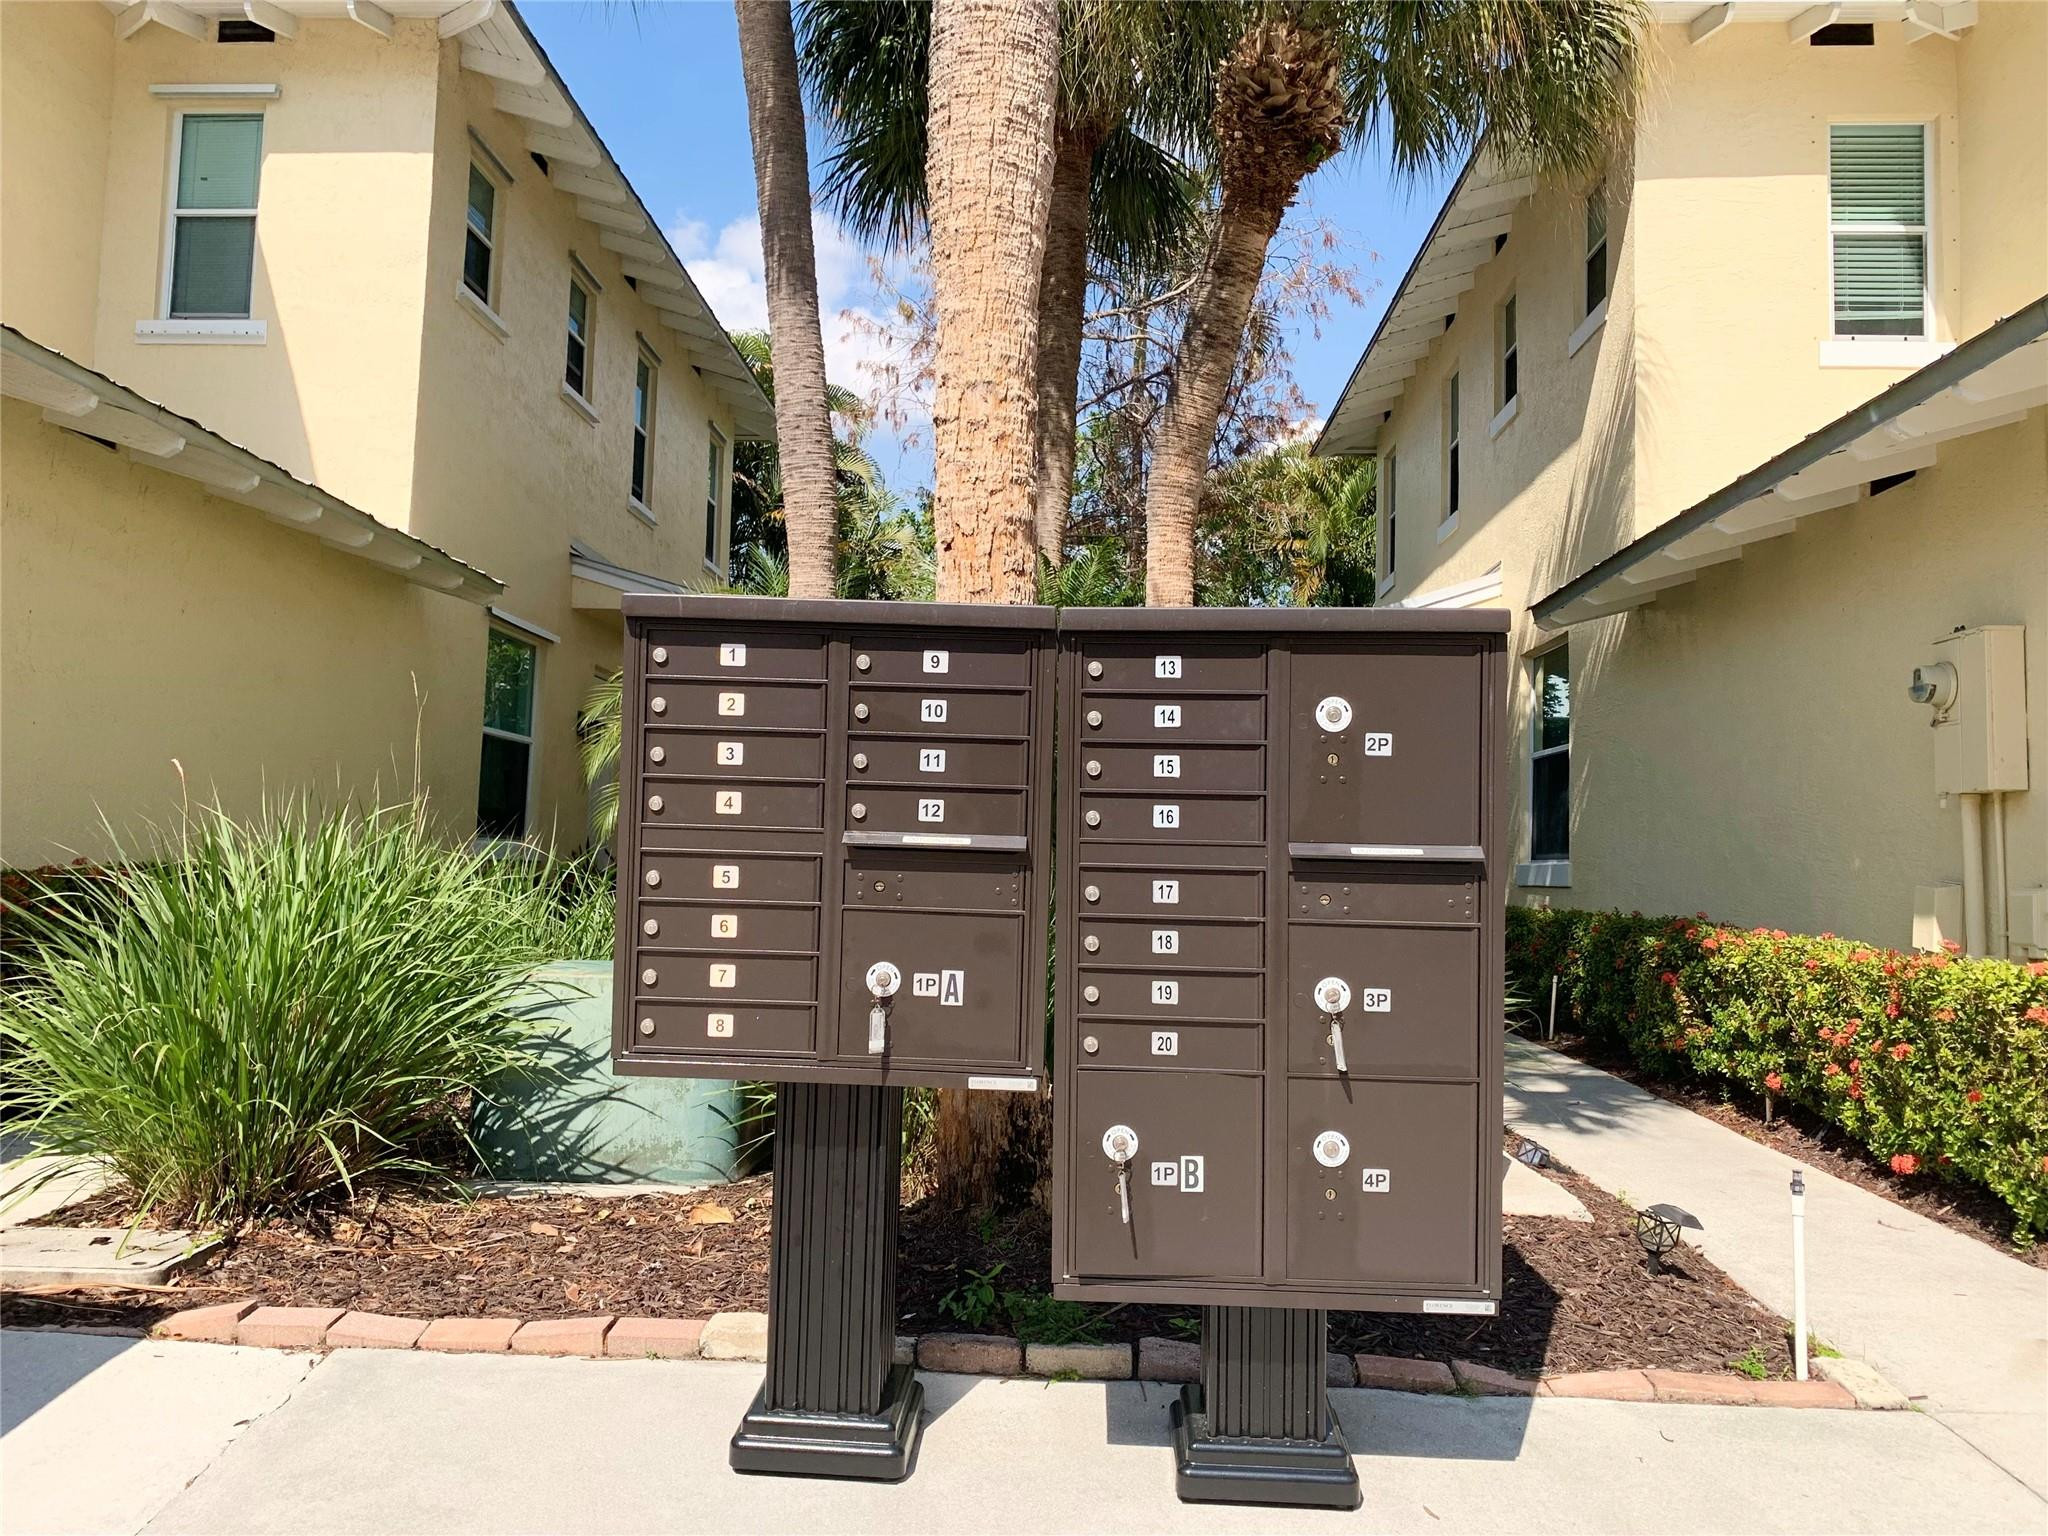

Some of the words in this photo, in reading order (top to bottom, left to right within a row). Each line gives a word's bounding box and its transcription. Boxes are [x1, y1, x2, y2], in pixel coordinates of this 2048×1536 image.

[728, 647, 736, 662] 1
[930, 655, 941, 668] 9
[1160, 661, 1176, 675] 13
[727, 697, 736, 712] 2
[924, 704, 944, 717] 10
[1160, 710, 1176, 723] 14
[1367, 738, 1389, 751] 2P
[725, 747, 735, 760] 3
[923, 754, 940, 767] 11
[1159, 760, 1174, 774] 15
[723, 796, 734, 809] 4
[922, 804, 941, 817] 12
[1158, 810, 1174, 824] 16
[721, 870, 731, 884] 5
[1158, 885, 1174, 899] 17
[719, 919, 729, 933] 6
[1157, 935, 1173, 949] 18
[718, 969, 728, 983] 7
[917, 978, 936, 991] 1P
[944, 974, 959, 1002] A
[1157, 986, 1172, 1000] 19
[1366, 994, 1387, 1007] 3P
[715, 1018, 725, 1033] 8
[1157, 1037, 1172, 1051] 20
[1154, 1167, 1174, 1180] 1P
[1185, 1159, 1199, 1189] B
[1365, 1174, 1386, 1187] 4P
